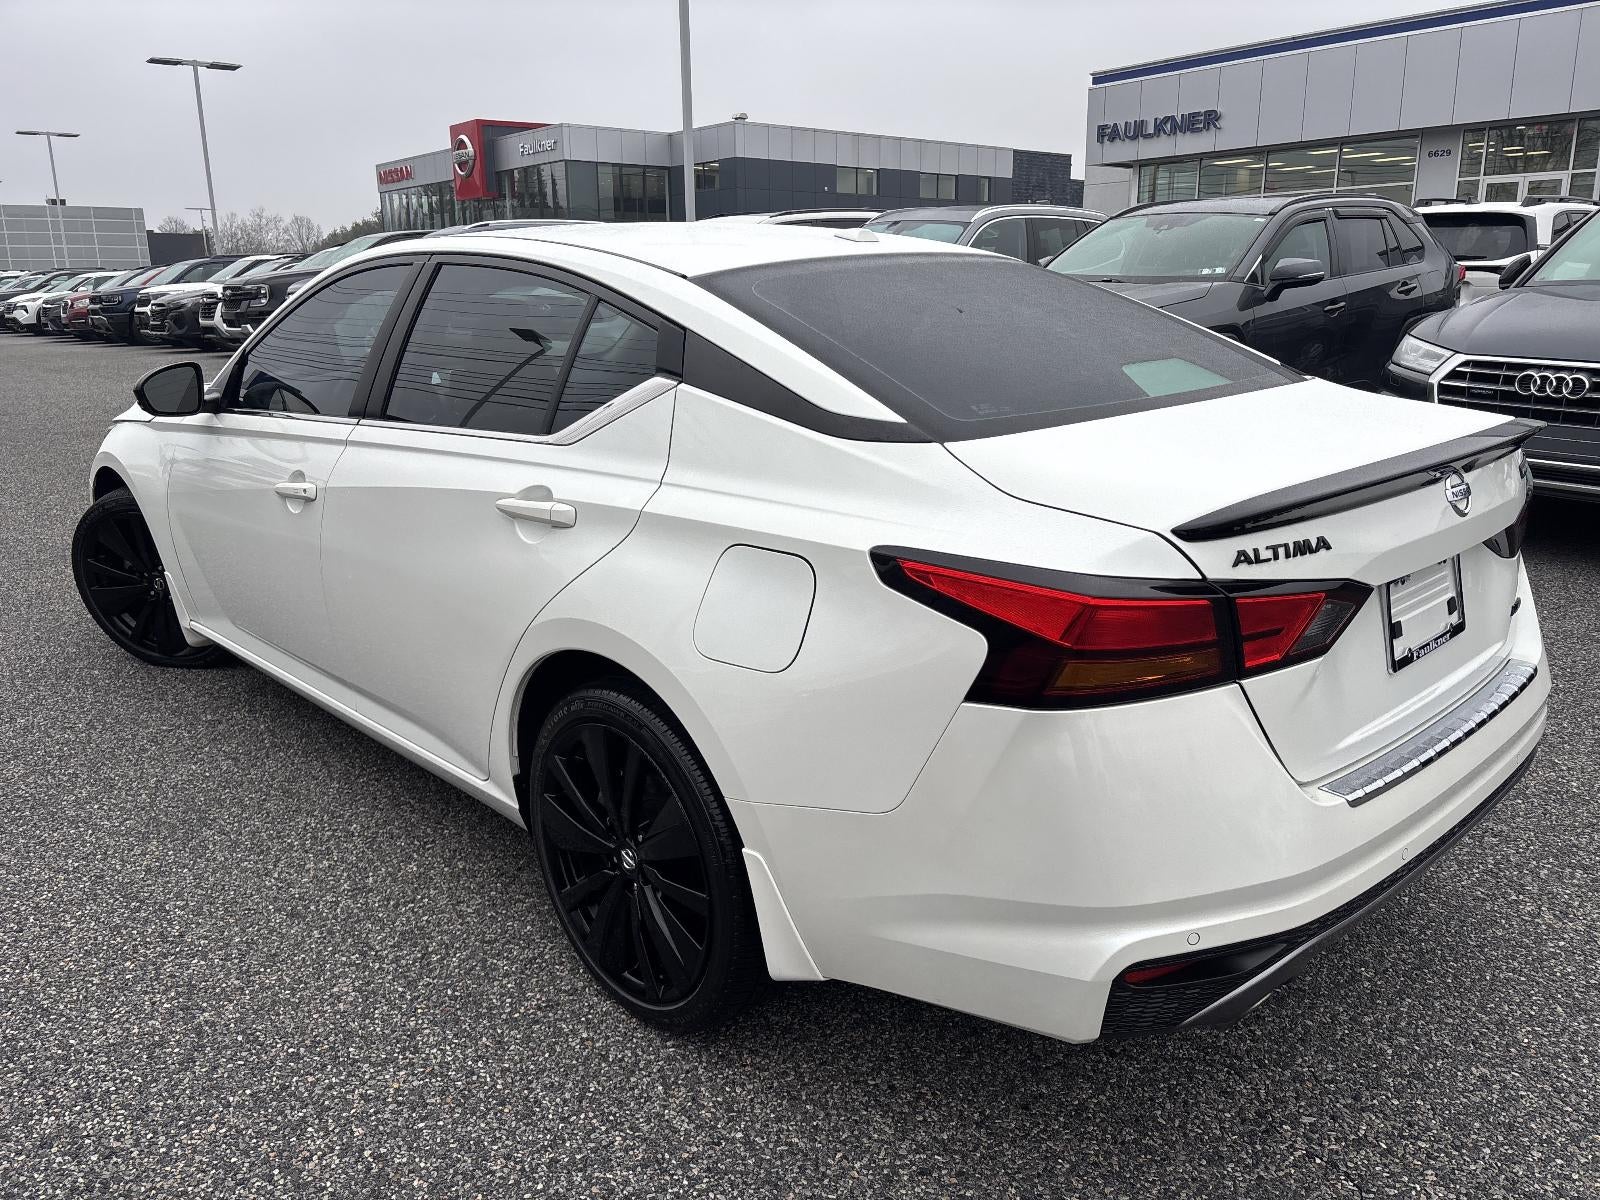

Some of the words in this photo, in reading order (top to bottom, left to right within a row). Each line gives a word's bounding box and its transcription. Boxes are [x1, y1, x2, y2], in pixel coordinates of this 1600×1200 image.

[1096, 109, 1221, 143] FAULKNER
[518, 139, 556, 156] Faulkner
[1427, 149, 1452, 158] 6629
[379, 165, 414, 185] NISSAN
[1232, 535, 1333, 568] ALTIMA
[1411, 632, 1452, 661] Faulkner
